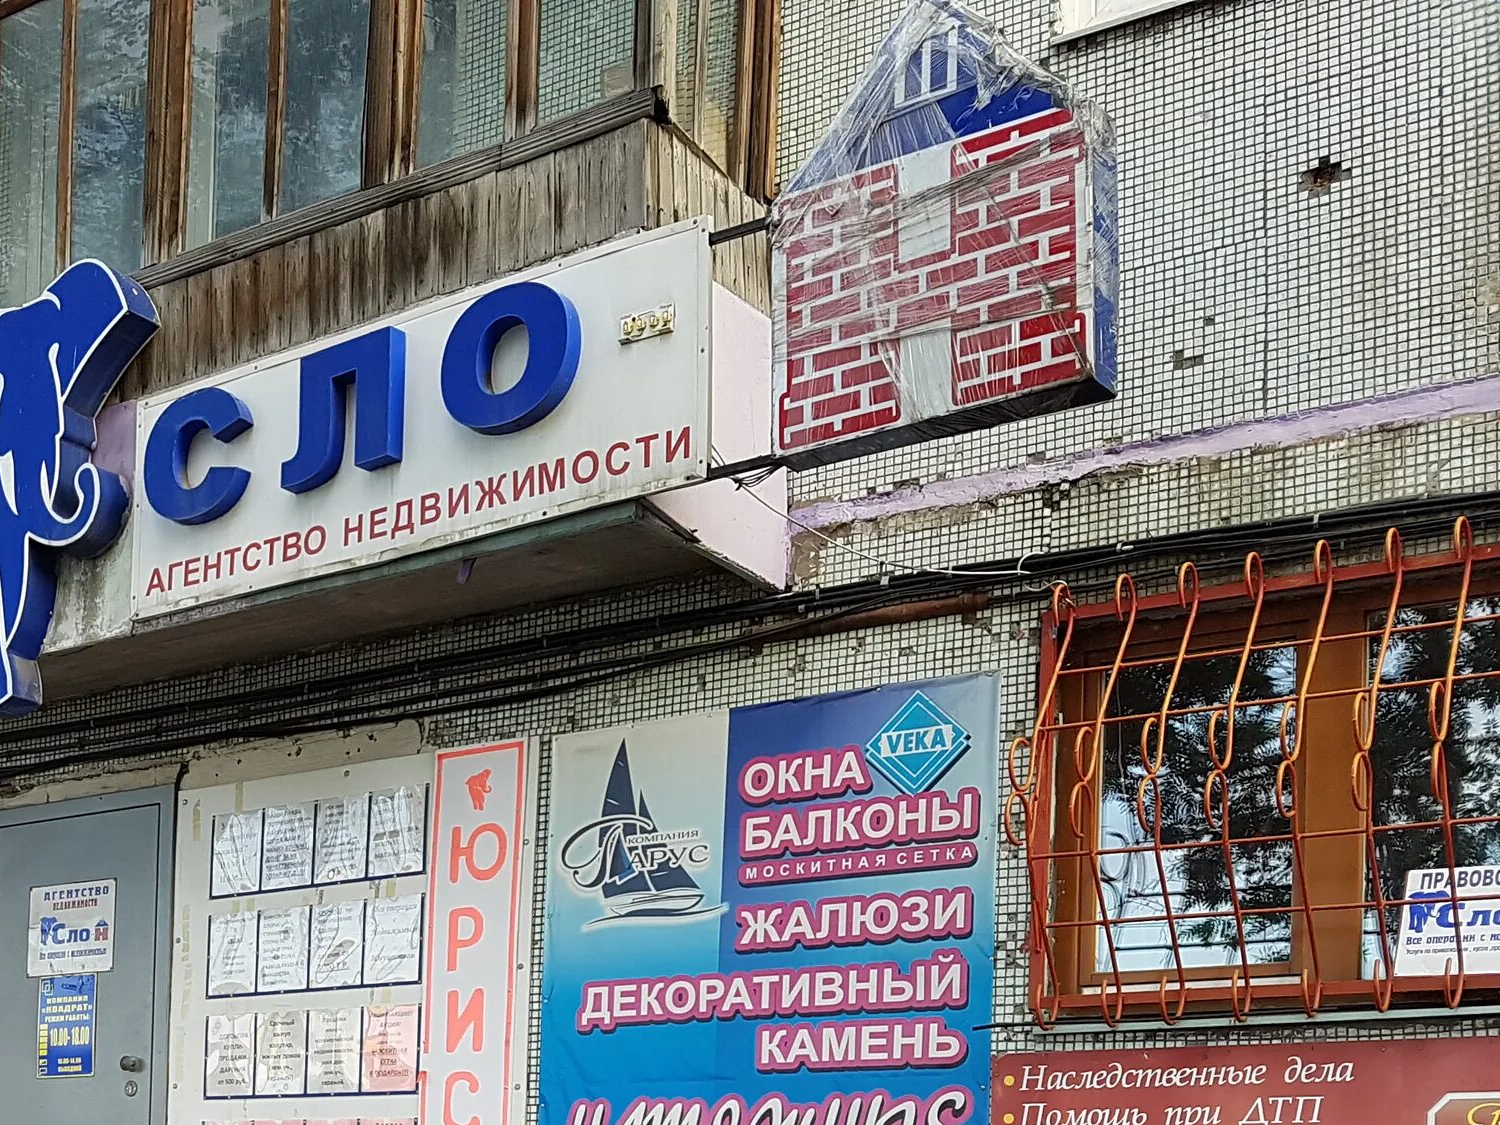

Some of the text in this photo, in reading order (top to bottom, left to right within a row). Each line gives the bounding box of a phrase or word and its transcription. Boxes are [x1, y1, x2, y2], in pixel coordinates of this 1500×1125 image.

[144, 280, 581, 525] СЛО
[145, 426, 692, 597] АГЕНТСТВО НЕДВИЖИМОСТИ
[885, 725, 949, 756] VEKA
[744, 751, 867, 798] ОКНА
[628, 829, 699, 846] КОМПАНИЯ
[744, 793, 976, 851] БАЛКОНЫ
[745, 847, 974, 880] МОСКИТНАЯ СЕТКА
[44, 886, 109, 901] АГЕНТСТВО
[53, 898, 98, 910] НЕДВИЖИМОСТИ
[739, 893, 965, 945] ЖАЛЮЗИ
[1406, 937, 1422, 945] Все
[1427, 934, 1475, 944] операии
[46, 995, 88, 1004] КОМПАНИЯ
[581, 955, 963, 1024] ДЕКОРАТИВНЫЙ
[760, 1023, 961, 1064] КАМЕНЬ
[1019, 1056, 1354, 1092] Наследственные дела
